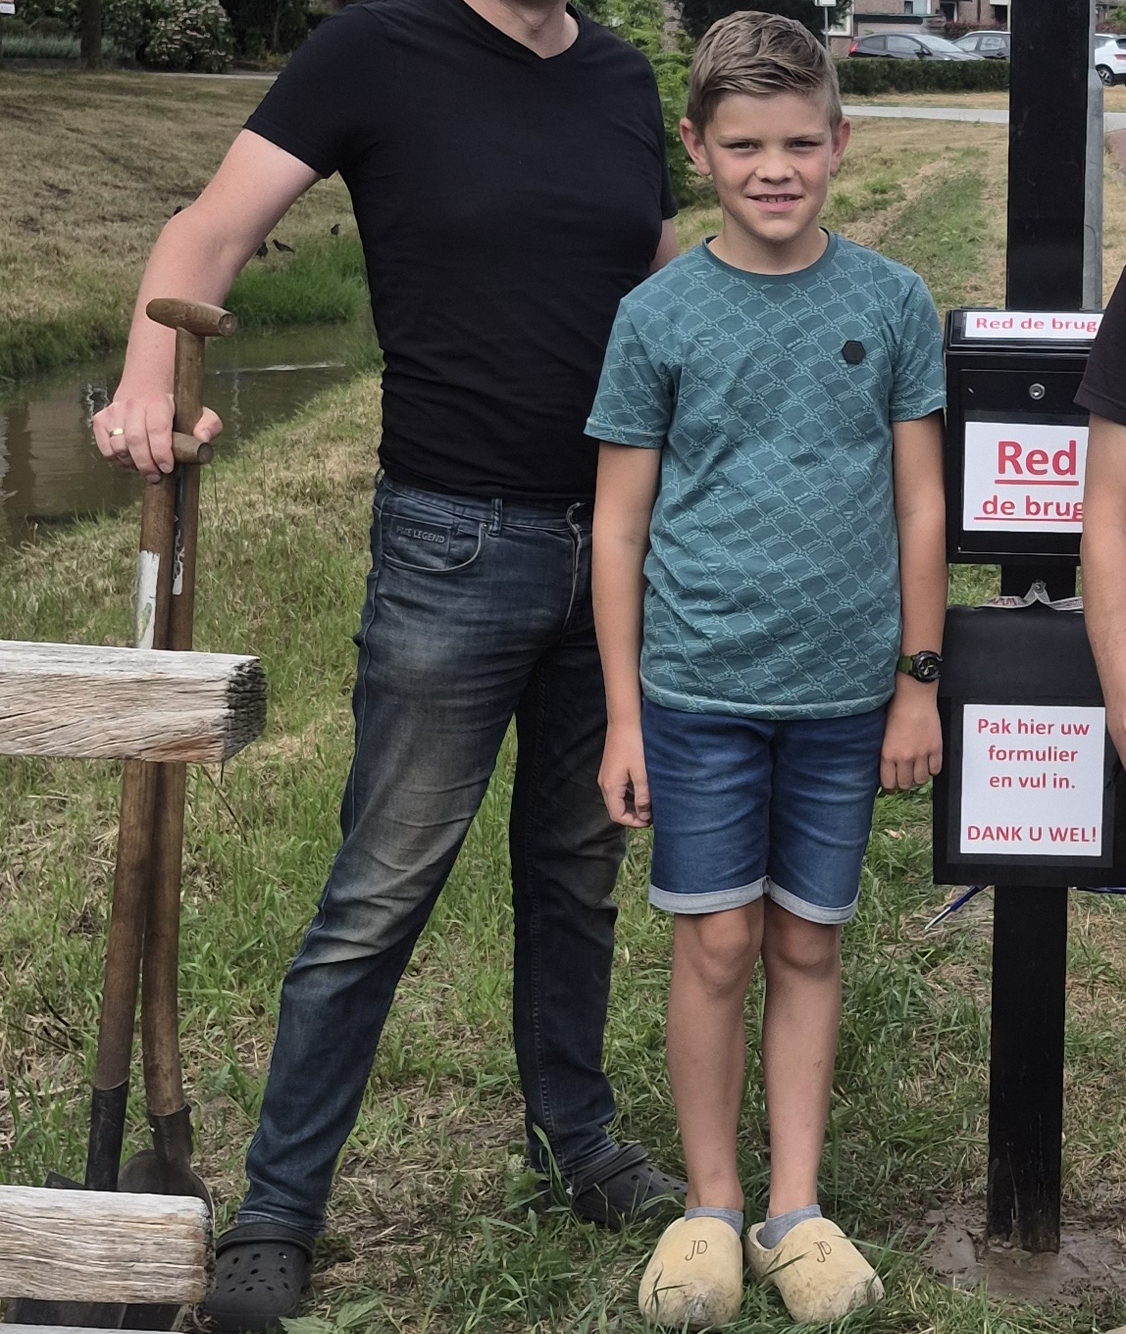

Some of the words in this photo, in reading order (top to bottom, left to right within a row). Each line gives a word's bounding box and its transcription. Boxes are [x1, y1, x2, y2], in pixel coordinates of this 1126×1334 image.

[976, 317, 1014, 330] Red
[1020, 317, 1045, 330] de
[1051, 317, 1098, 333] brug
[997, 439, 1077, 476] Red
[982, 495, 1016, 516] de
[977, 718, 1012, 734] Pak
[1017, 718, 1055, 735] hier
[1060, 723, 1090, 736] uw
[988, 745, 1079, 763] formulier
[989, 776, 1012, 788] en
[1018, 773, 1047, 789] vul
[1053, 773, 1076, 789] in.
[967, 825, 1022, 841] DANK
[1029, 826, 1042, 842] U
[1049, 826, 1097, 843] WEL!
[684, 1239, 708, 1262] JD
[812, 1240, 832, 1263] JD
